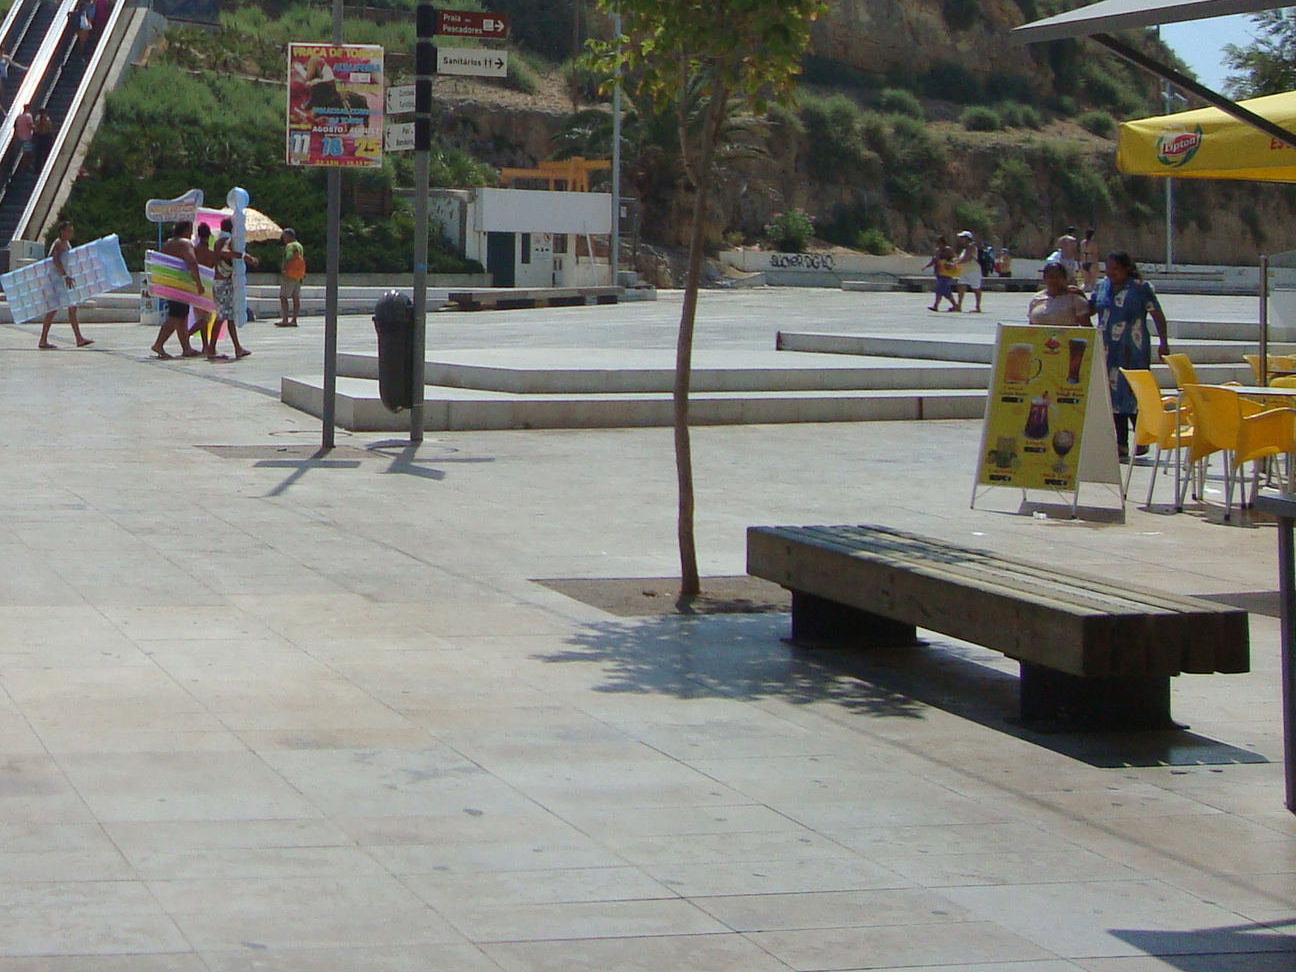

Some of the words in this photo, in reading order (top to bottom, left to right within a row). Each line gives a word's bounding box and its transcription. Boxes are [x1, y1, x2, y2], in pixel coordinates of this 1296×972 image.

[443, 13, 461, 22] Praia
[442, 24, 483, 34] Pescadores
[443, 56, 482, 66] Sanitários
[294, 134, 311, 154] 11
[354, 138, 381, 157] 25
[1165, 137, 1196, 153] Lipton
